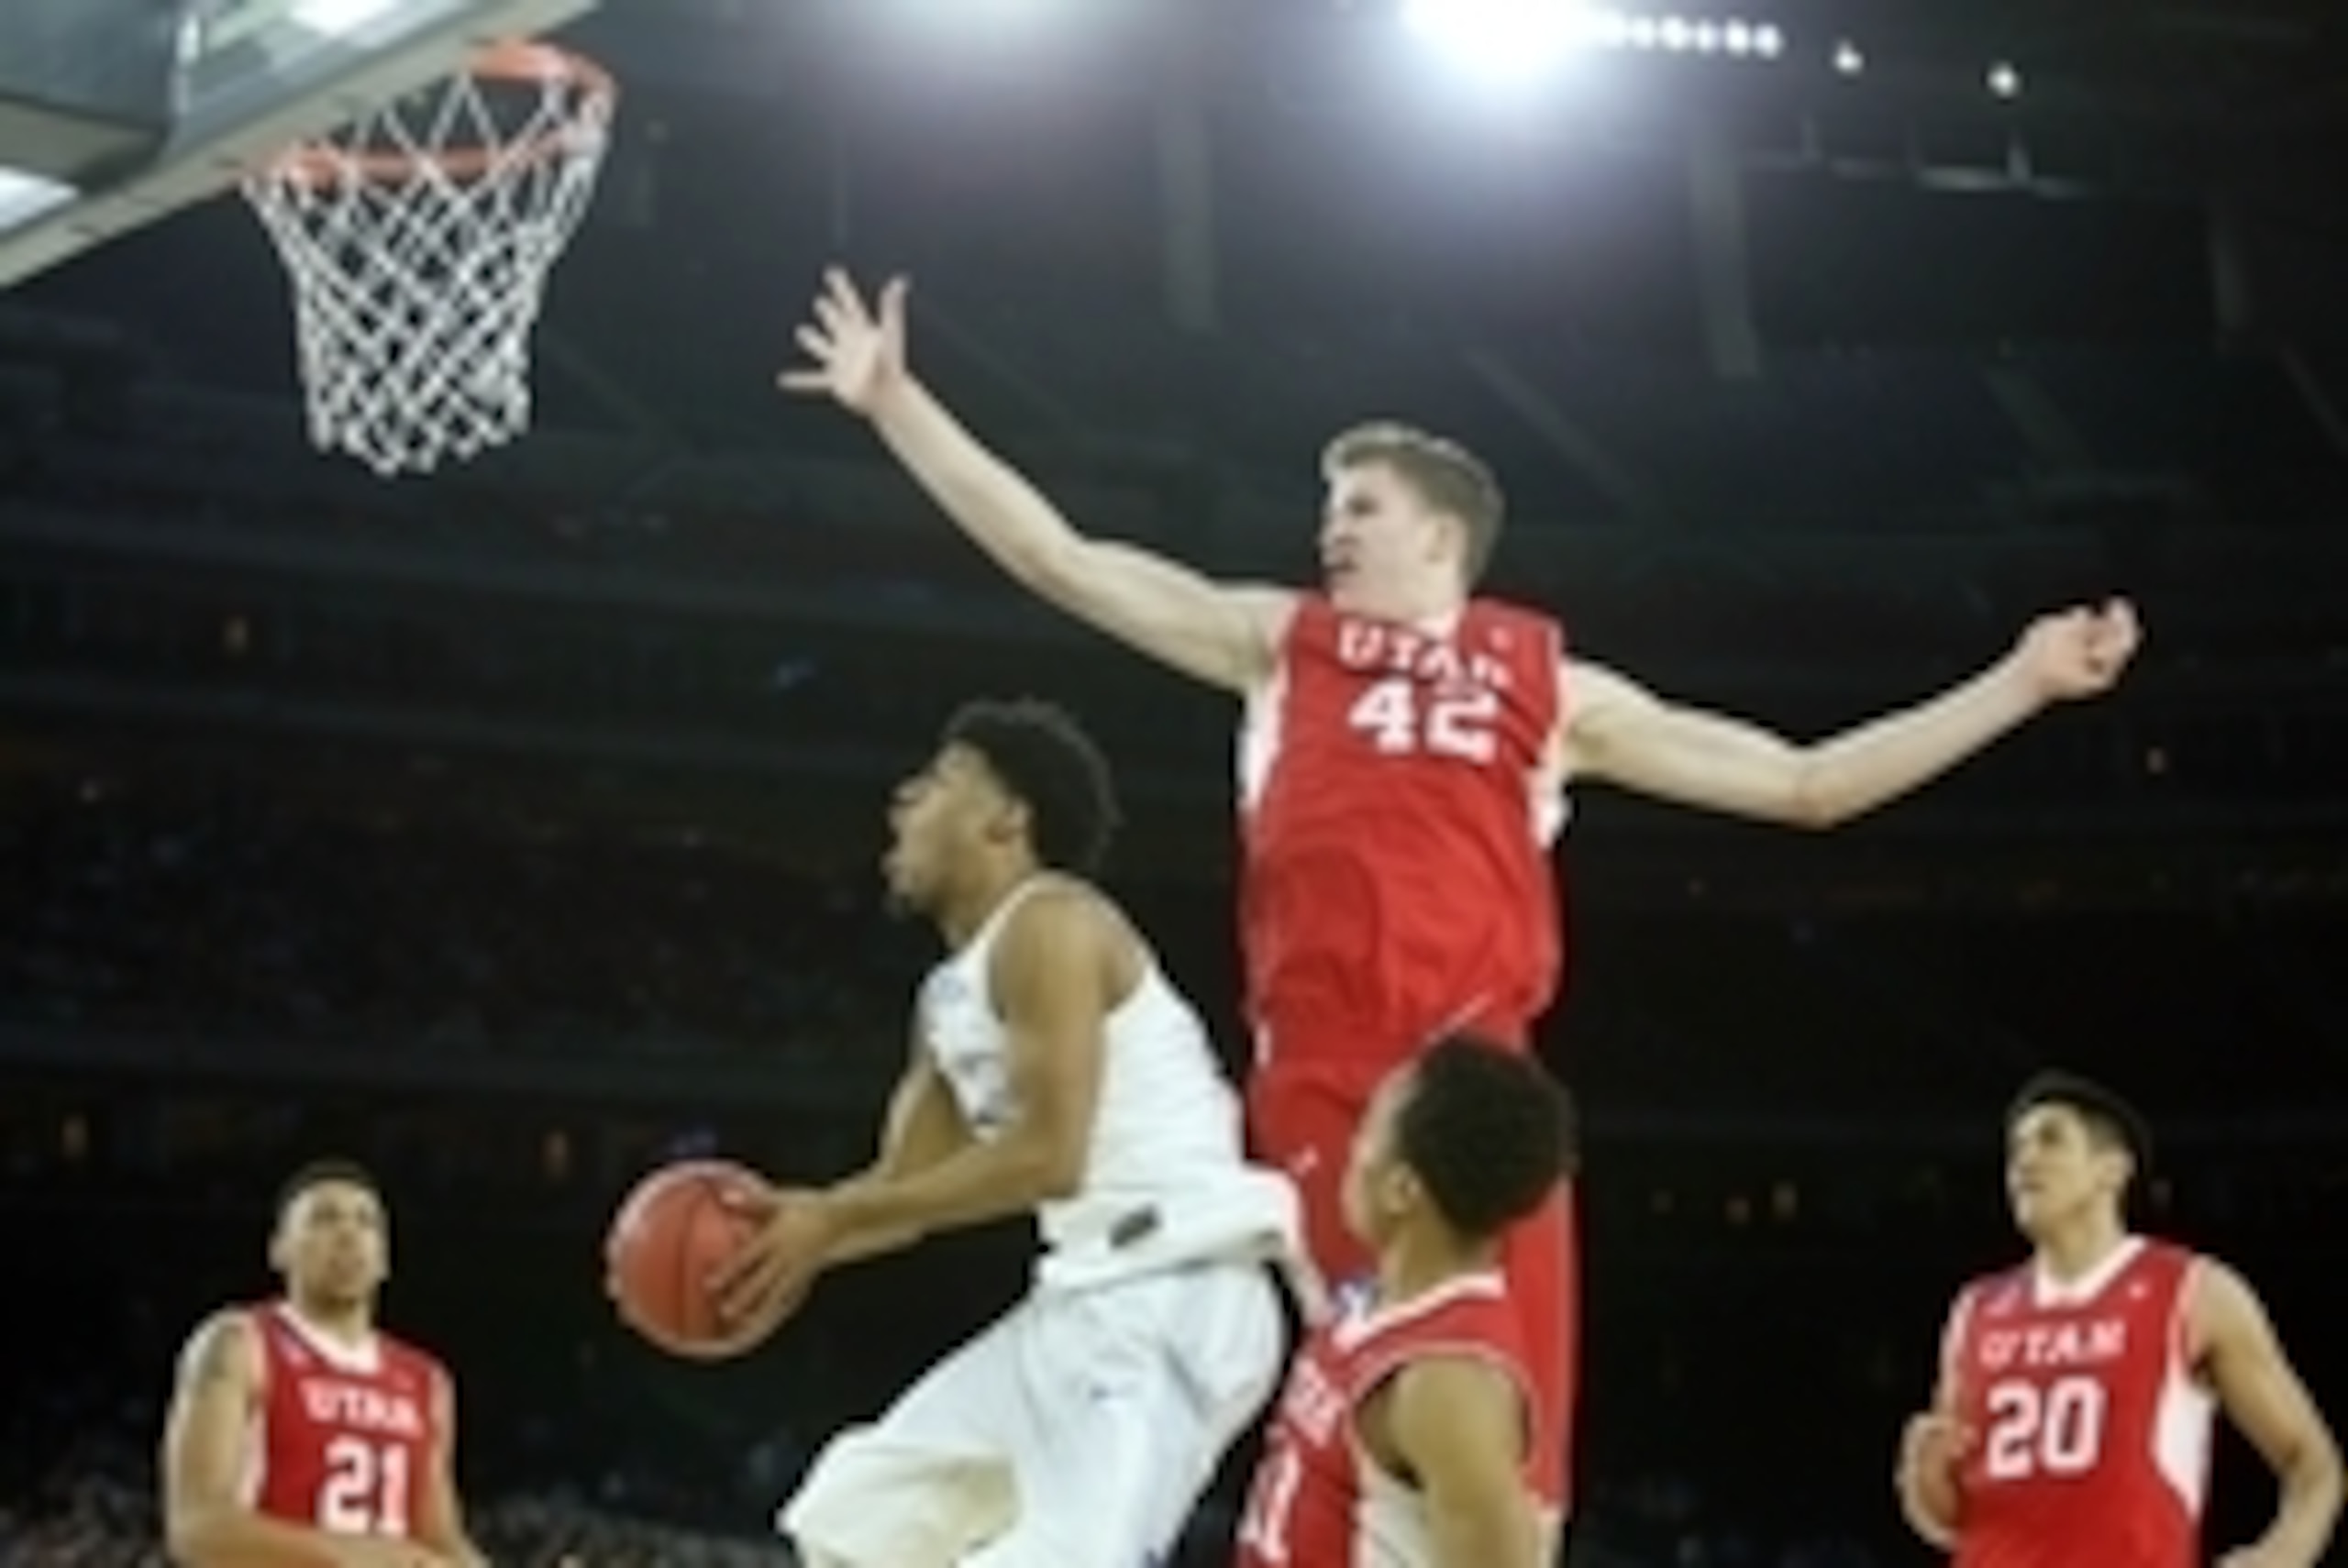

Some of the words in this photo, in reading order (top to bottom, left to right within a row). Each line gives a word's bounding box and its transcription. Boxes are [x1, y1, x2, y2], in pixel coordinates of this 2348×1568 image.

[1347, 676, 1500, 763] 42
[1978, 1321, 2126, 1371] UTAH
[298, 1378, 423, 1439] UTAH
[1986, 1377, 2104, 1479] 20
[322, 1435, 408, 1536] 21
